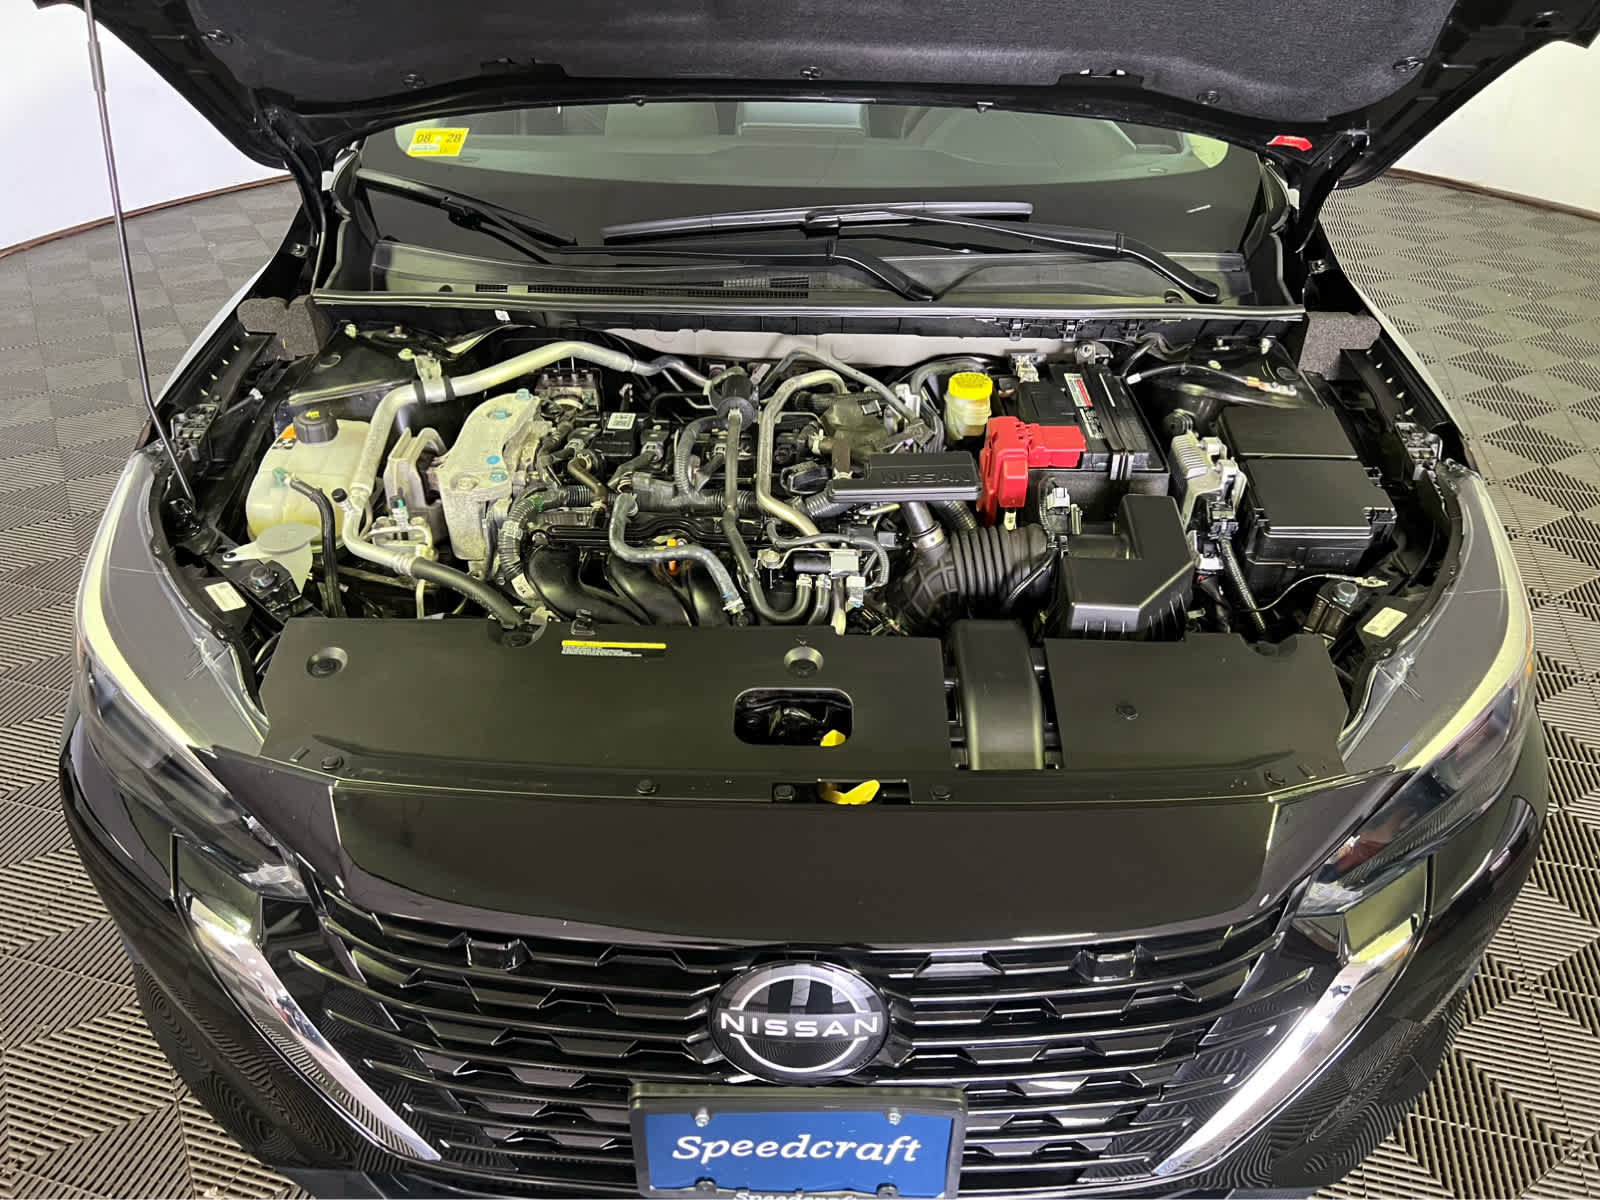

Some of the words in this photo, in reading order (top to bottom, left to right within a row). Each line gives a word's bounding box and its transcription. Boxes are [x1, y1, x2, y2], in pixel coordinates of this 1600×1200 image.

[880, 472, 971, 484] NISSAN
[720, 1012, 878, 1037] NISSAN
[672, 1134, 921, 1165] Speedcraft
